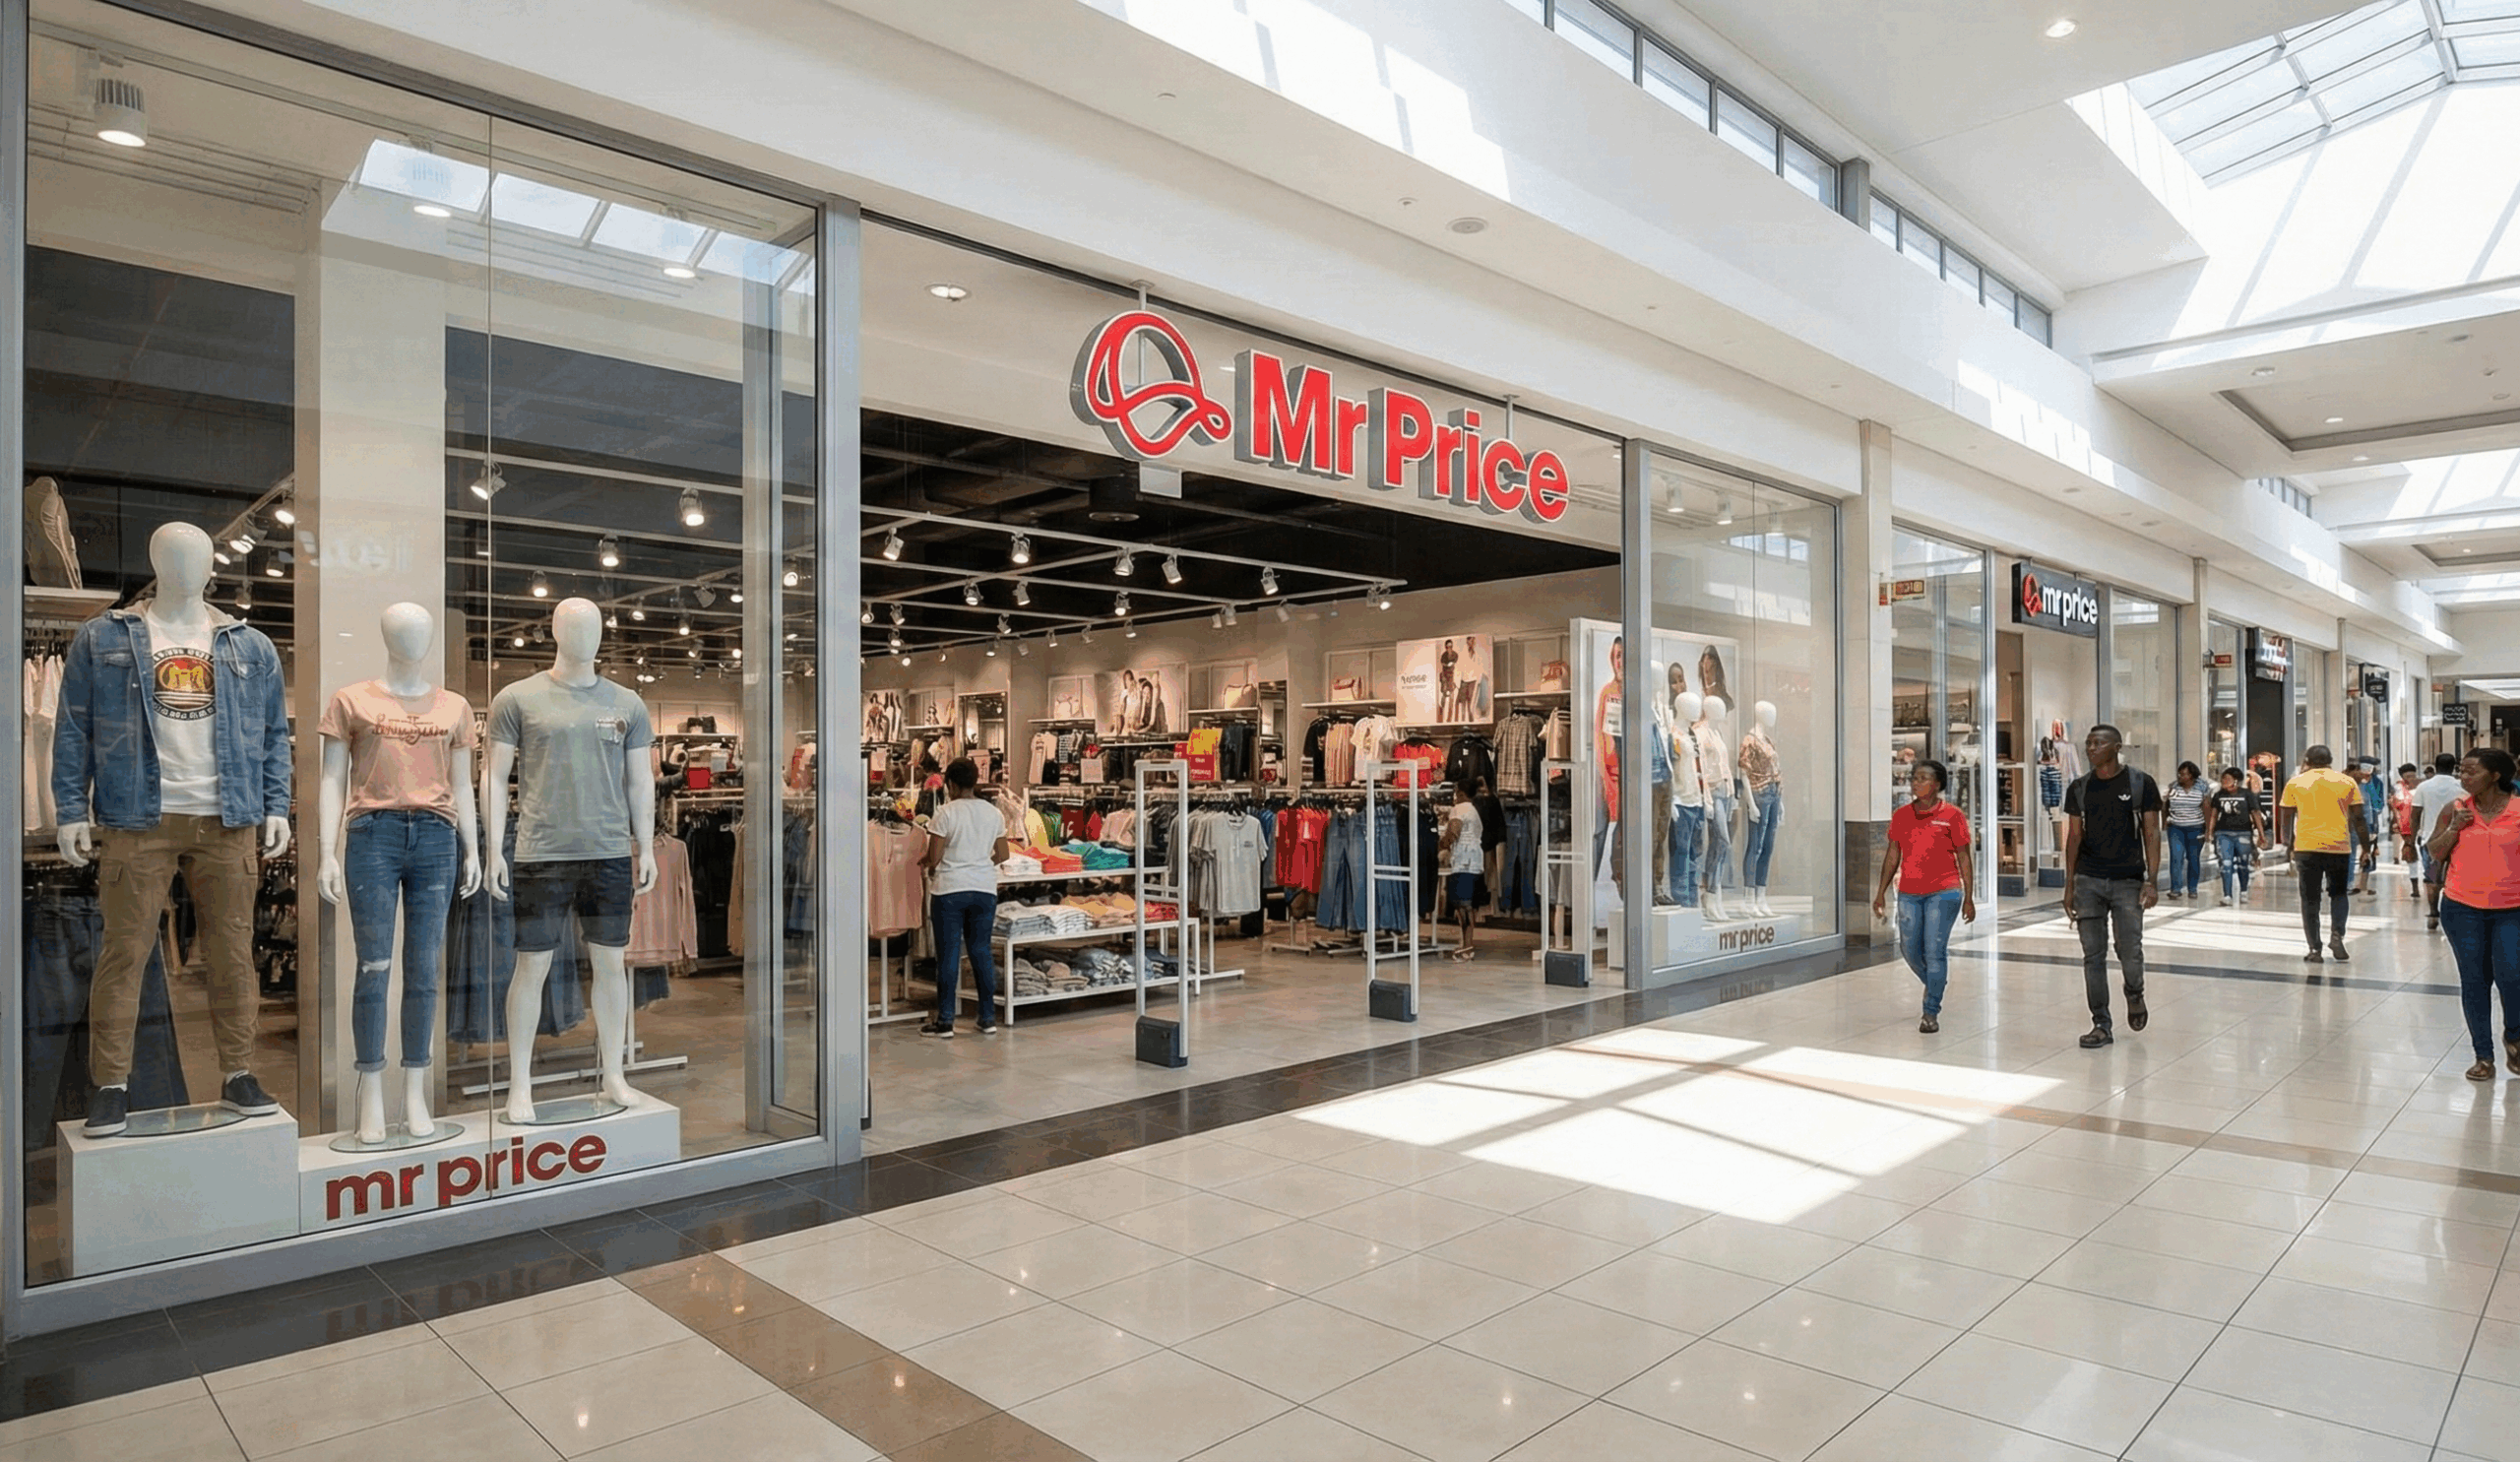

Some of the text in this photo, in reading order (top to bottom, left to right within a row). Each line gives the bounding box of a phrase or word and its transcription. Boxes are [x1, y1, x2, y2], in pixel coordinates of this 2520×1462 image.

[1246, 349, 1570, 524] Mr Price
[2042, 585, 2098, 627] mr price
[1719, 923, 1775, 953] mr price
[325, 1135, 607, 1221] mr price
